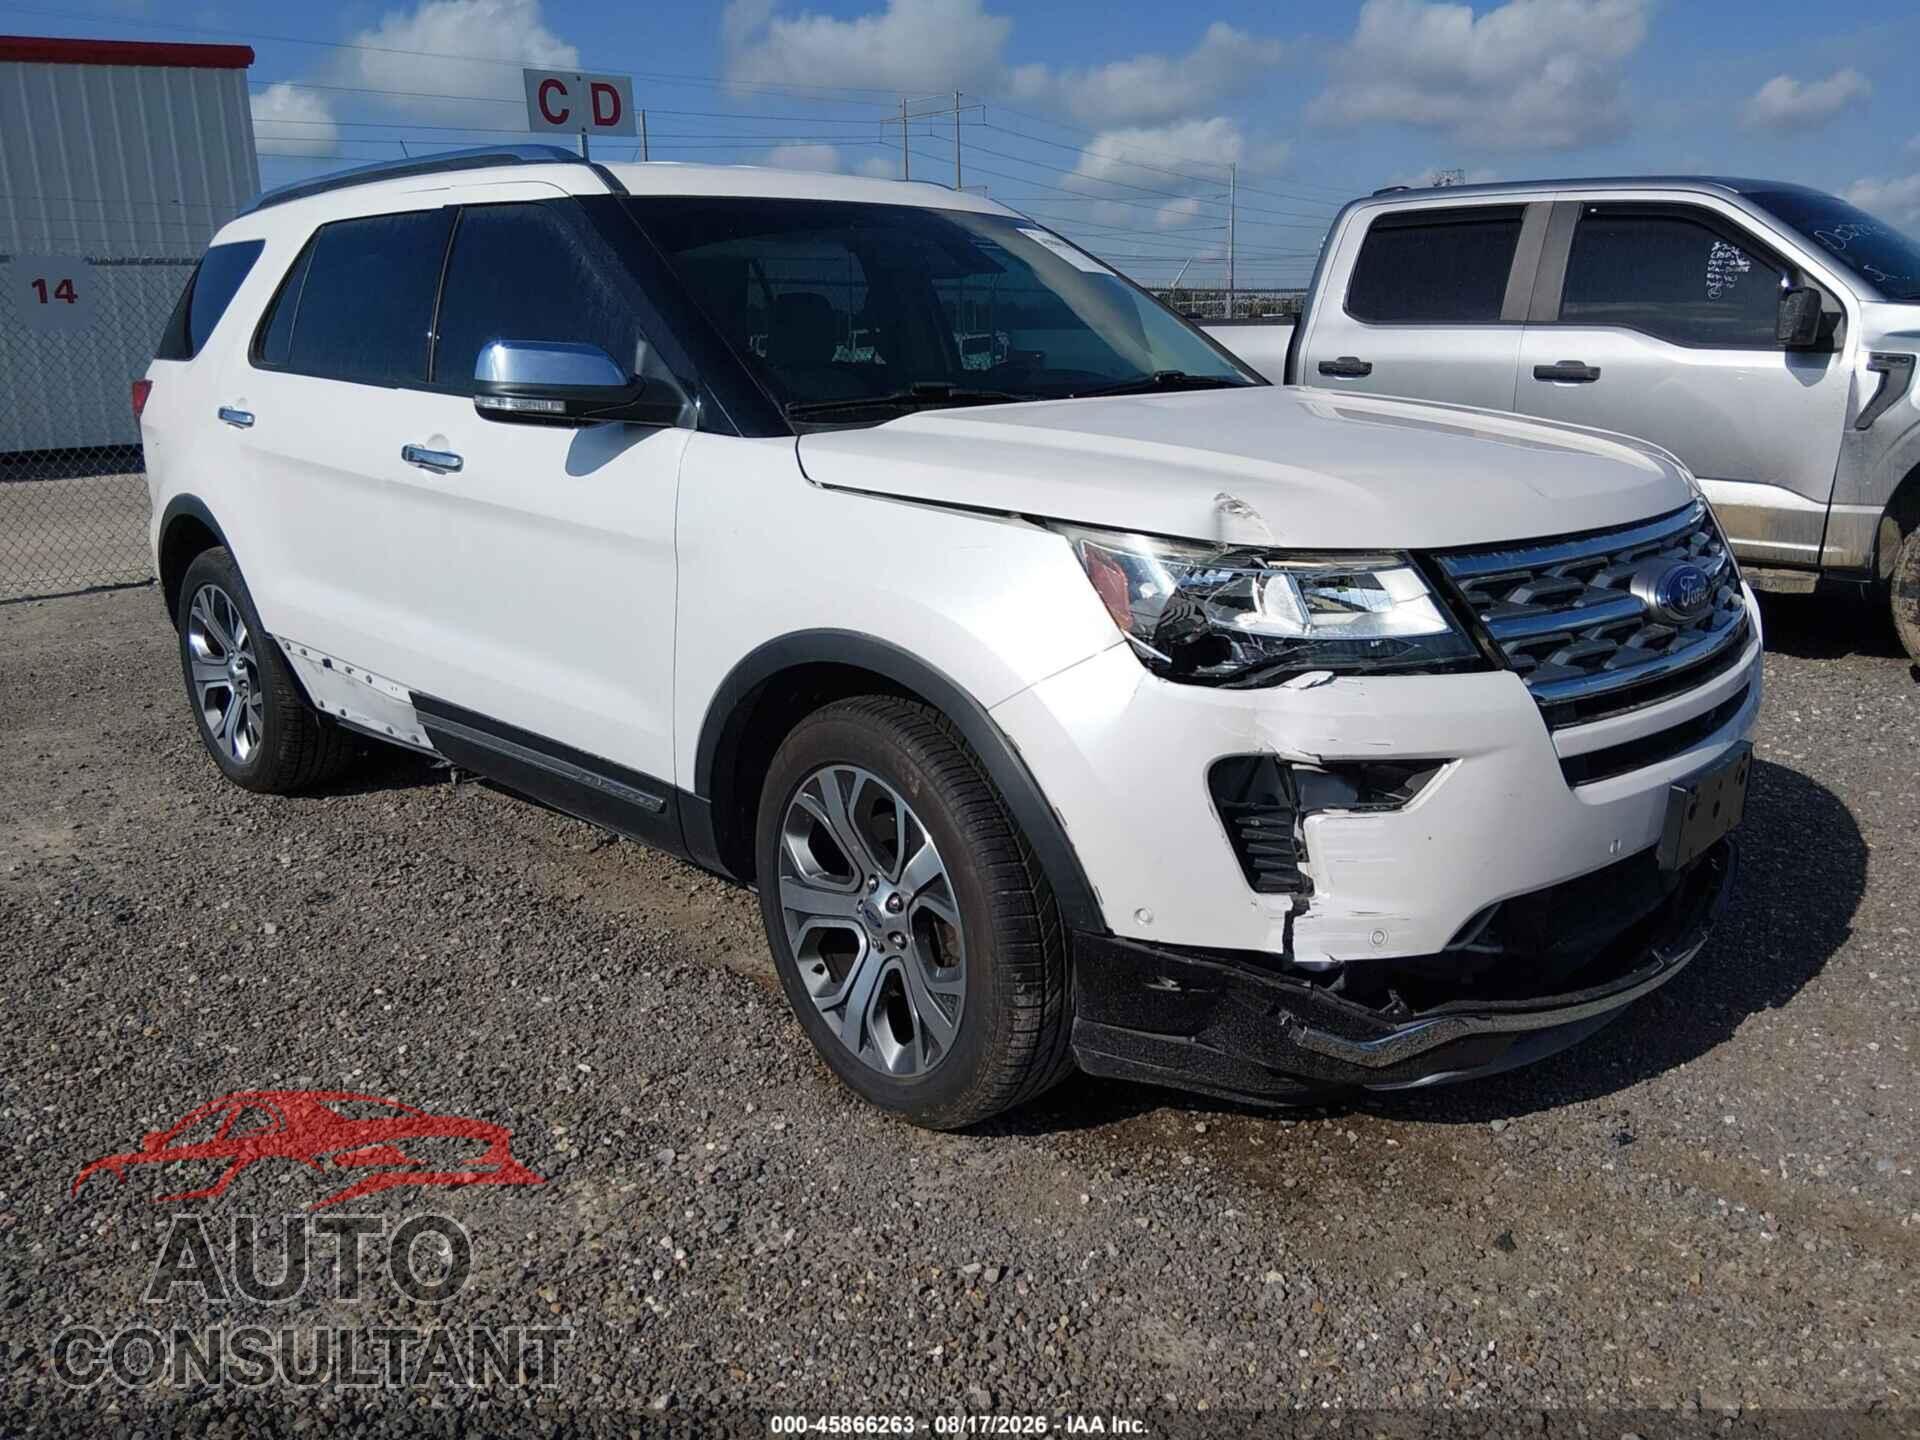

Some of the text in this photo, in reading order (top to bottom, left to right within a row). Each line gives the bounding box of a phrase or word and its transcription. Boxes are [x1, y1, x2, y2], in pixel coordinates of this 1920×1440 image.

[538, 78, 622, 127] C D
[32, 278, 79, 304] 14
